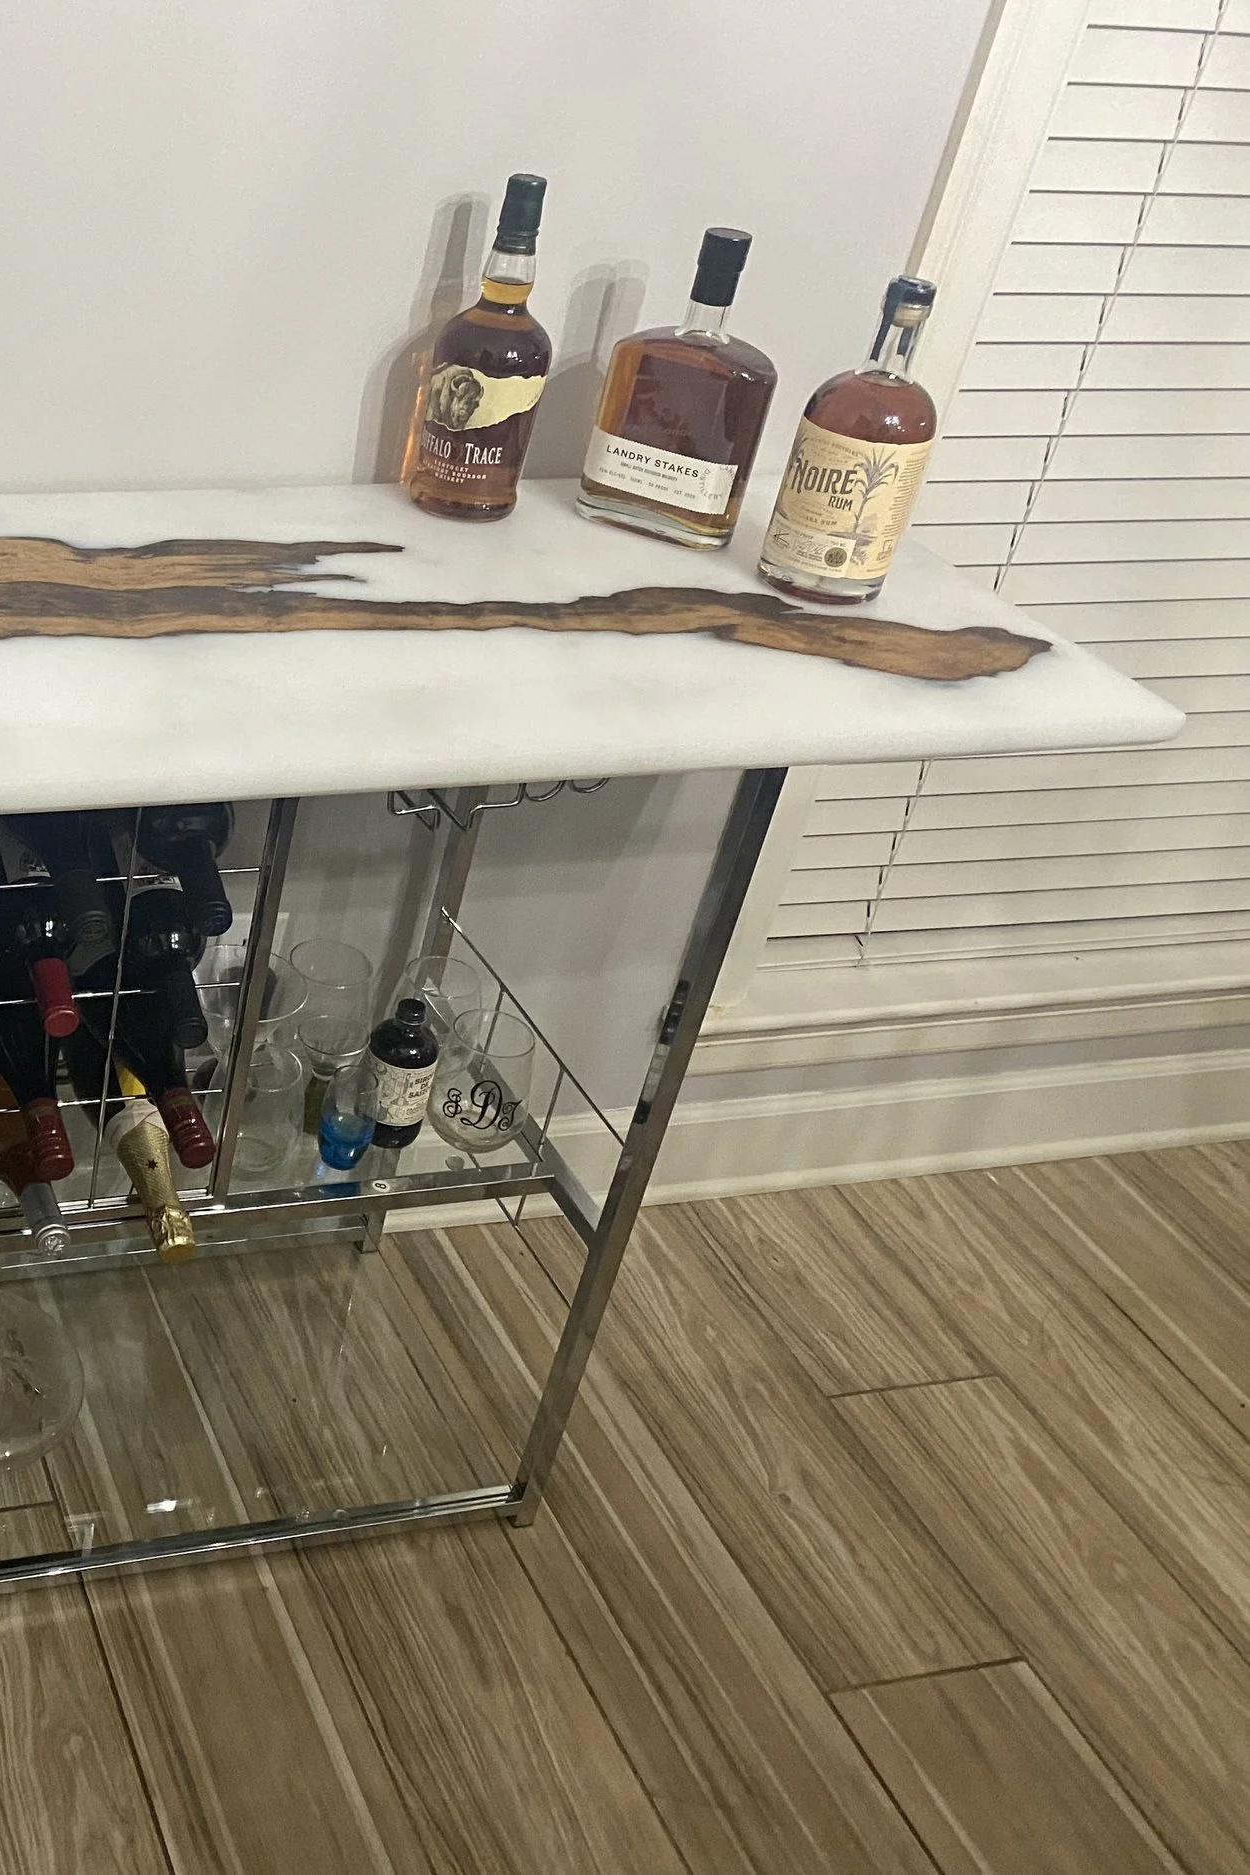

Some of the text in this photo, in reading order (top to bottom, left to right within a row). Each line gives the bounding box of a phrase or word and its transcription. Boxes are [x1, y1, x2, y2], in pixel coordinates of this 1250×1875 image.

[423, 433, 503, 465] FFALO TRACE
[606, 444, 652, 465] LANDRY
[654, 459, 699, 478] STAKES
[791, 458, 858, 495] NOIRE
[828, 495, 854, 511] RUM
[415, 1073, 434, 1085] SIRO
